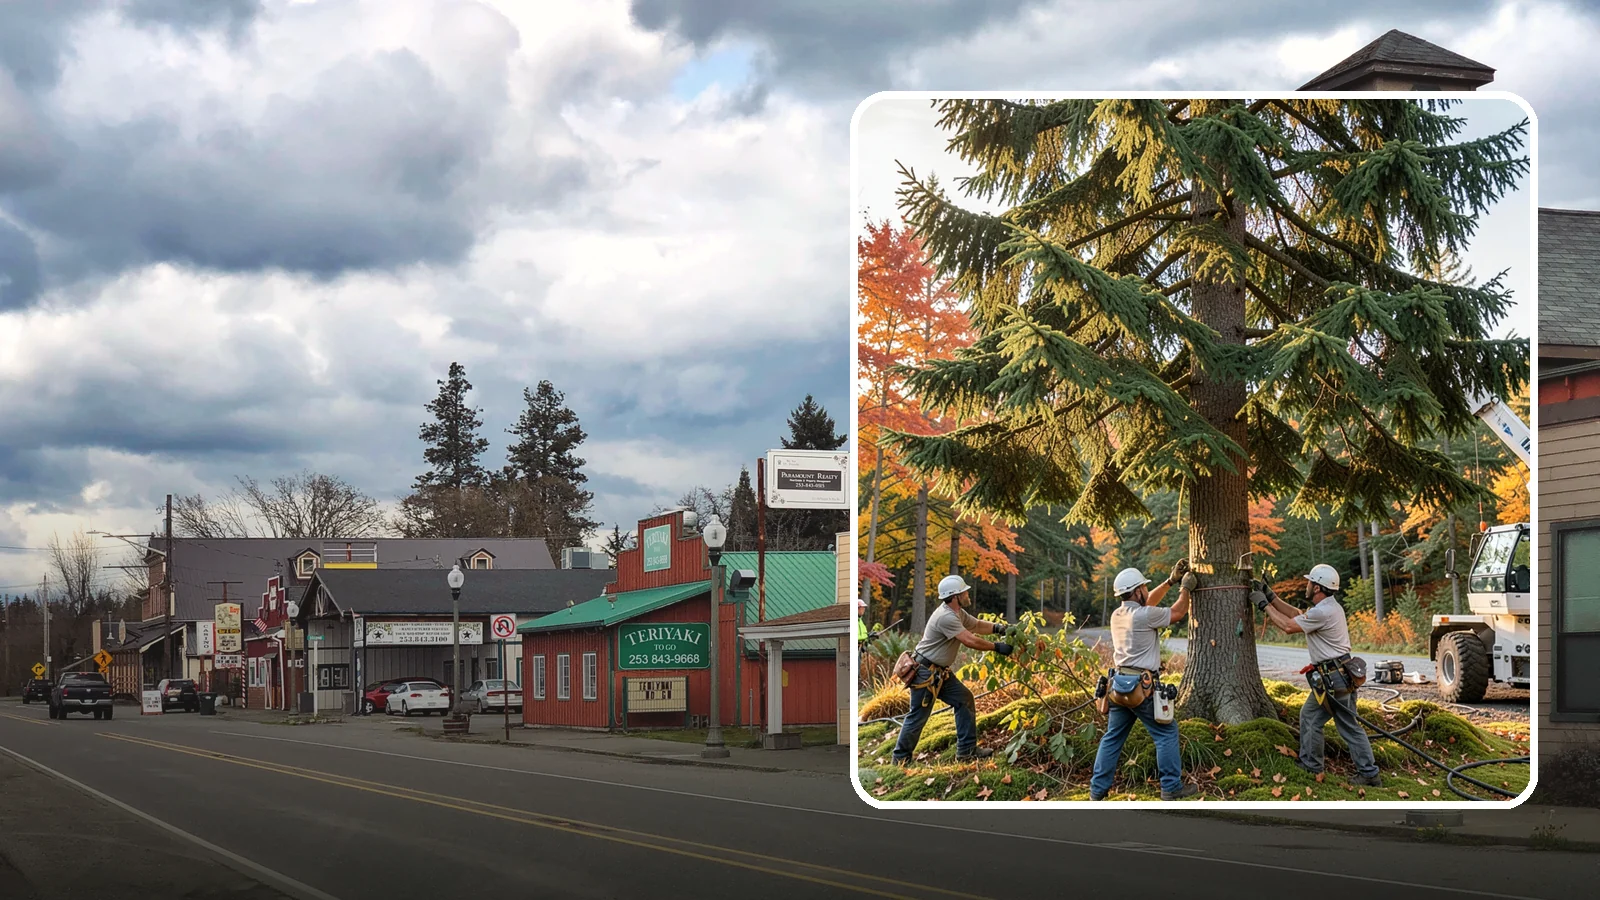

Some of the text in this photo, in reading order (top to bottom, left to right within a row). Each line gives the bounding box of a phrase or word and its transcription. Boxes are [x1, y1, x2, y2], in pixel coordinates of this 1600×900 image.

[624, 627, 702, 646] TERIYAKI
[629, 653, 700, 665] 253 843-9668
[639, 681, 673, 690] TERIYAKI
